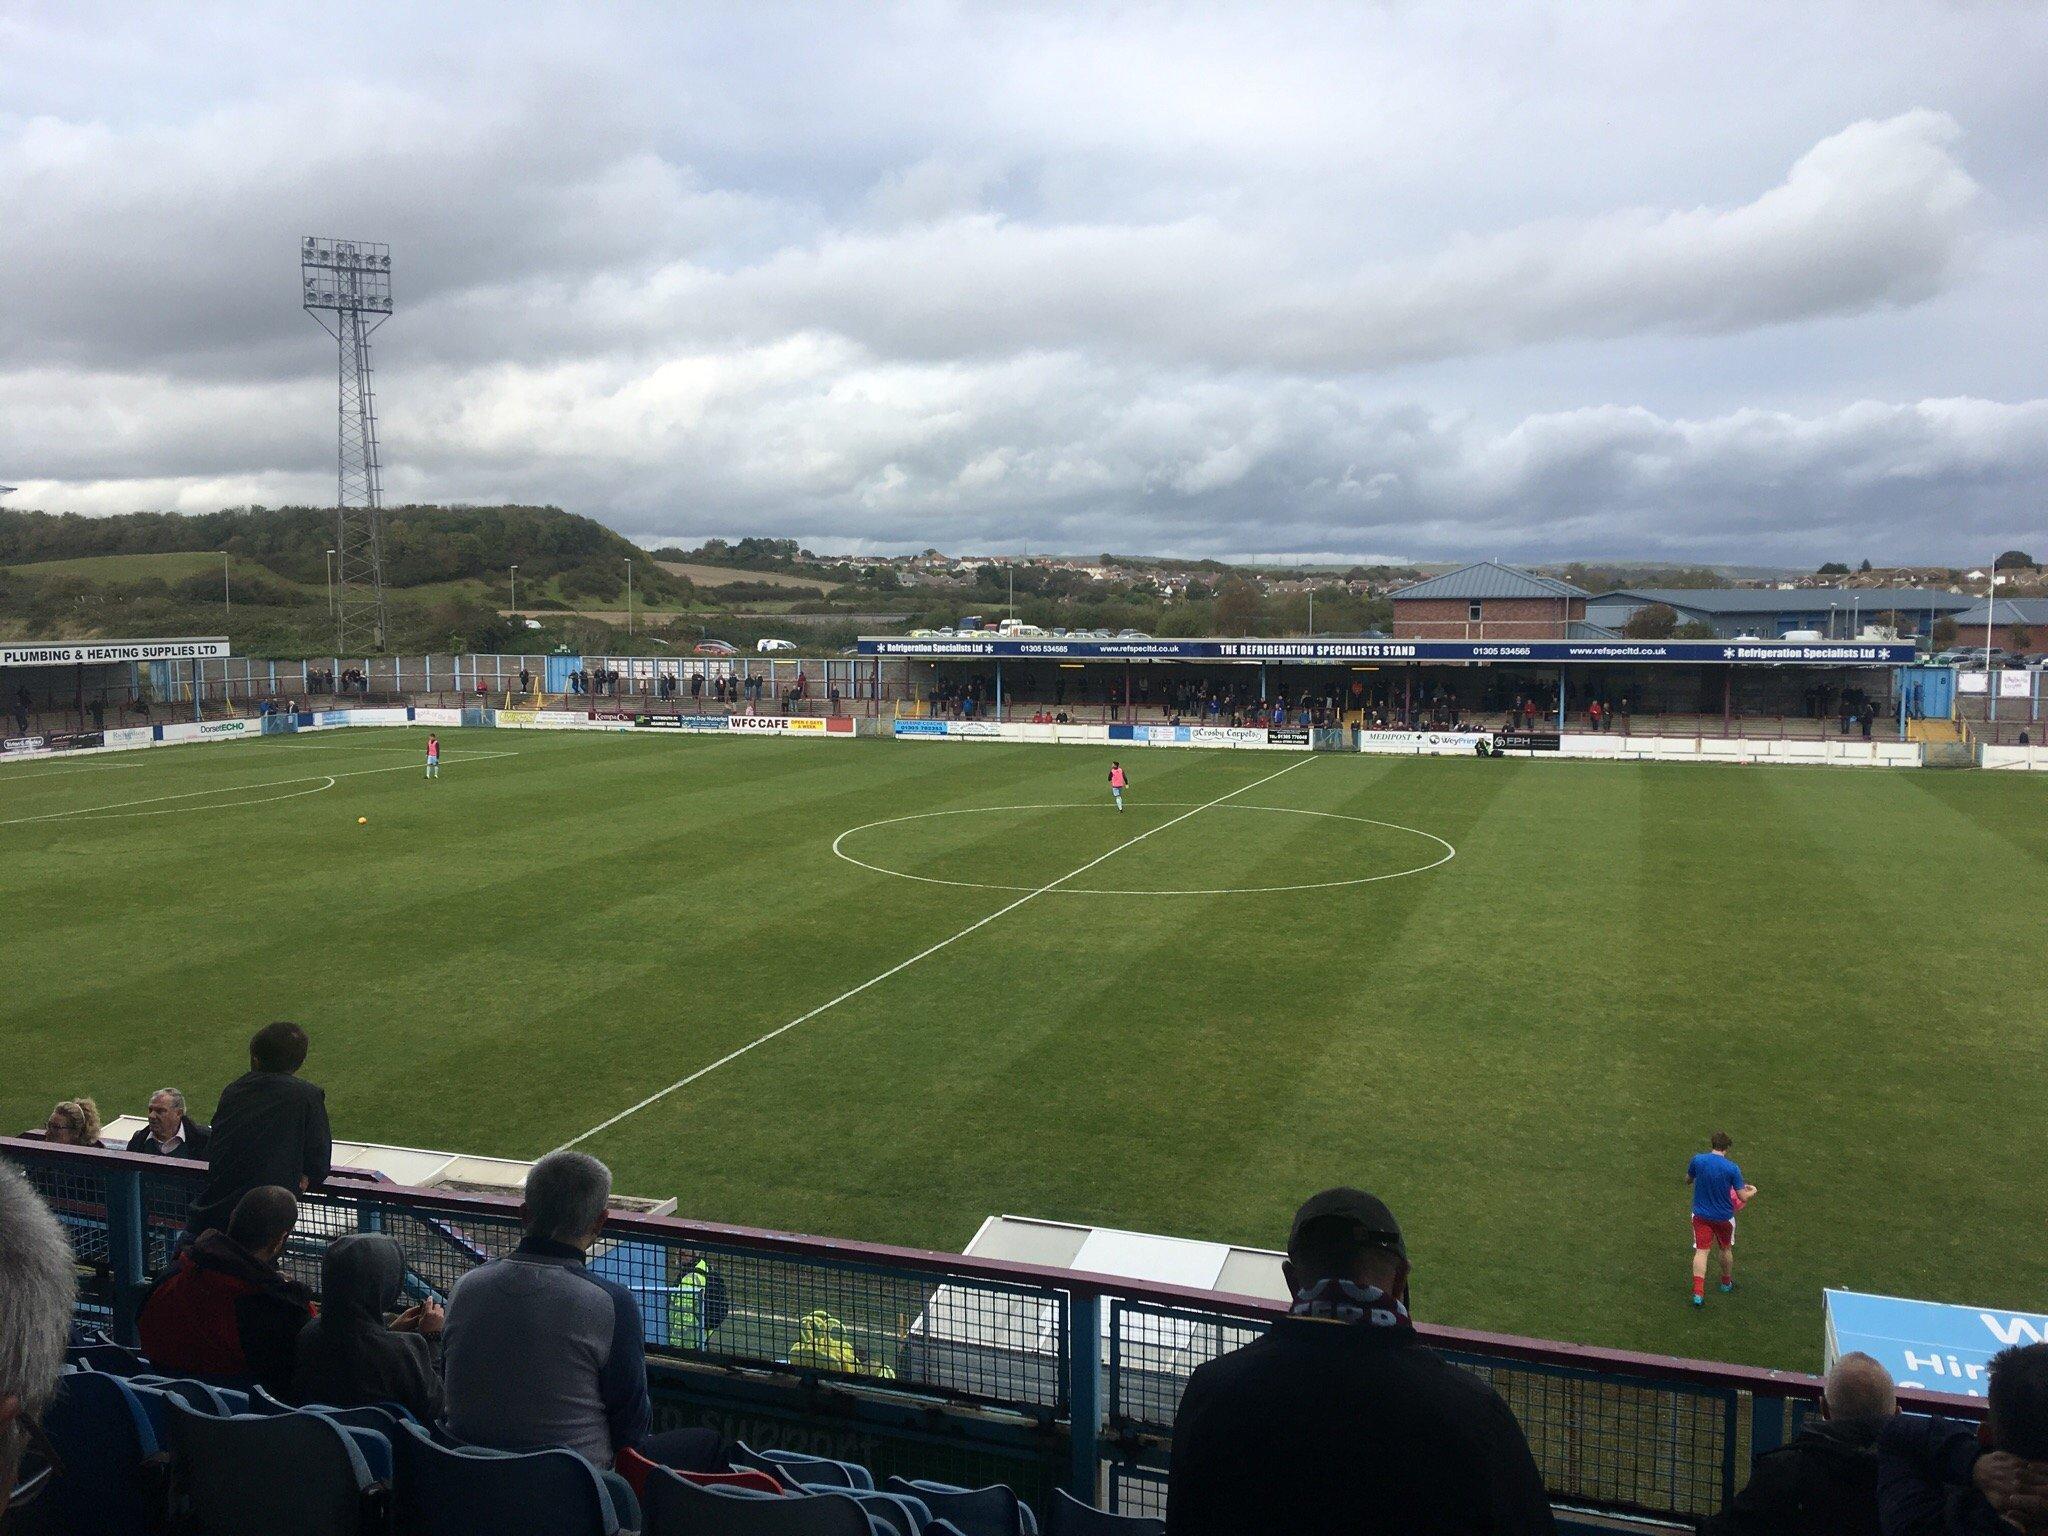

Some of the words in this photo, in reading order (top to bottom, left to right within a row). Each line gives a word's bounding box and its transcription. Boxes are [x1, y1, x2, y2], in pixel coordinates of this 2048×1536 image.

[5, 650, 70, 662] PLUMBING
[75, 650, 83, 660] &
[87, 648, 138, 660] HEATING
[142, 646, 195, 657] SUPPLIES
[198, 646, 217, 655] LTD
[887, 643, 932, 653] Refrigeration
[933, 644, 971, 654] Specialists
[972, 644, 983, 653] Ltd
[1220, 645, 1237, 655] THE
[1240, 645, 1313, 656] REFRIGERATION
[1316, 646, 1380, 656] SPECIALISTS
[1383, 647, 1416, 656] STAND
[1738, 648, 1800, 658] Refrigeration
[1803, 648, 1858, 659] Specialists
[1860, 649, 1875, 658] Ltd
[200, 723, 244, 733] DorsetECHO
[731, 719, 756, 728] WFC
[758, 719, 788, 728] CAFE
[1200, 728, 1224, 738] Crosby
[1227, 729, 1257, 740] Carpets
[1369, 733, 1411, 741] MEDIPOST
[1507, 737, 1531, 745] FPH
[1904, 1350, 1990, 1381] Hir
